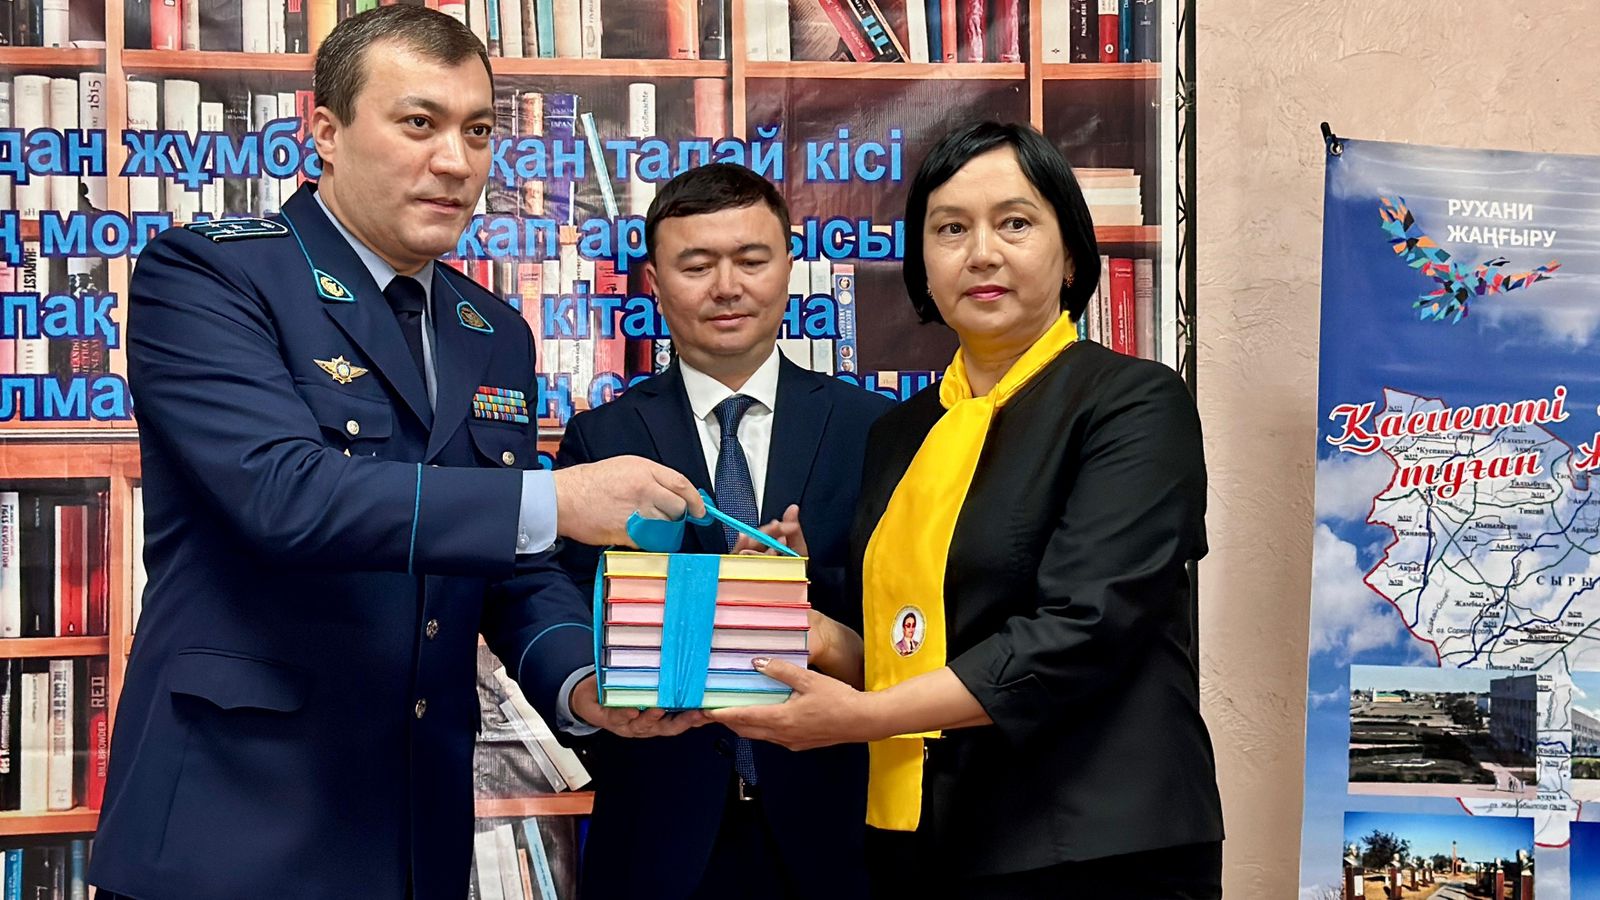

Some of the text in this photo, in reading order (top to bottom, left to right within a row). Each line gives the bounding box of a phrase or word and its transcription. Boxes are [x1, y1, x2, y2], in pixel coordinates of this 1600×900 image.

[87, 80, 102, 109] 1815
[805, 127, 903, 182] кісі
[1447, 198, 1534, 221] РУХАНИ
[1446, 224, 1557, 248] ЖАҢҒЫРУ
[1326, 385, 1570, 455] Қасиетті
[1398, 451, 1545, 500] туған
[91, 676, 105, 708] RED
[97, 721, 107, 760] BROWDER
